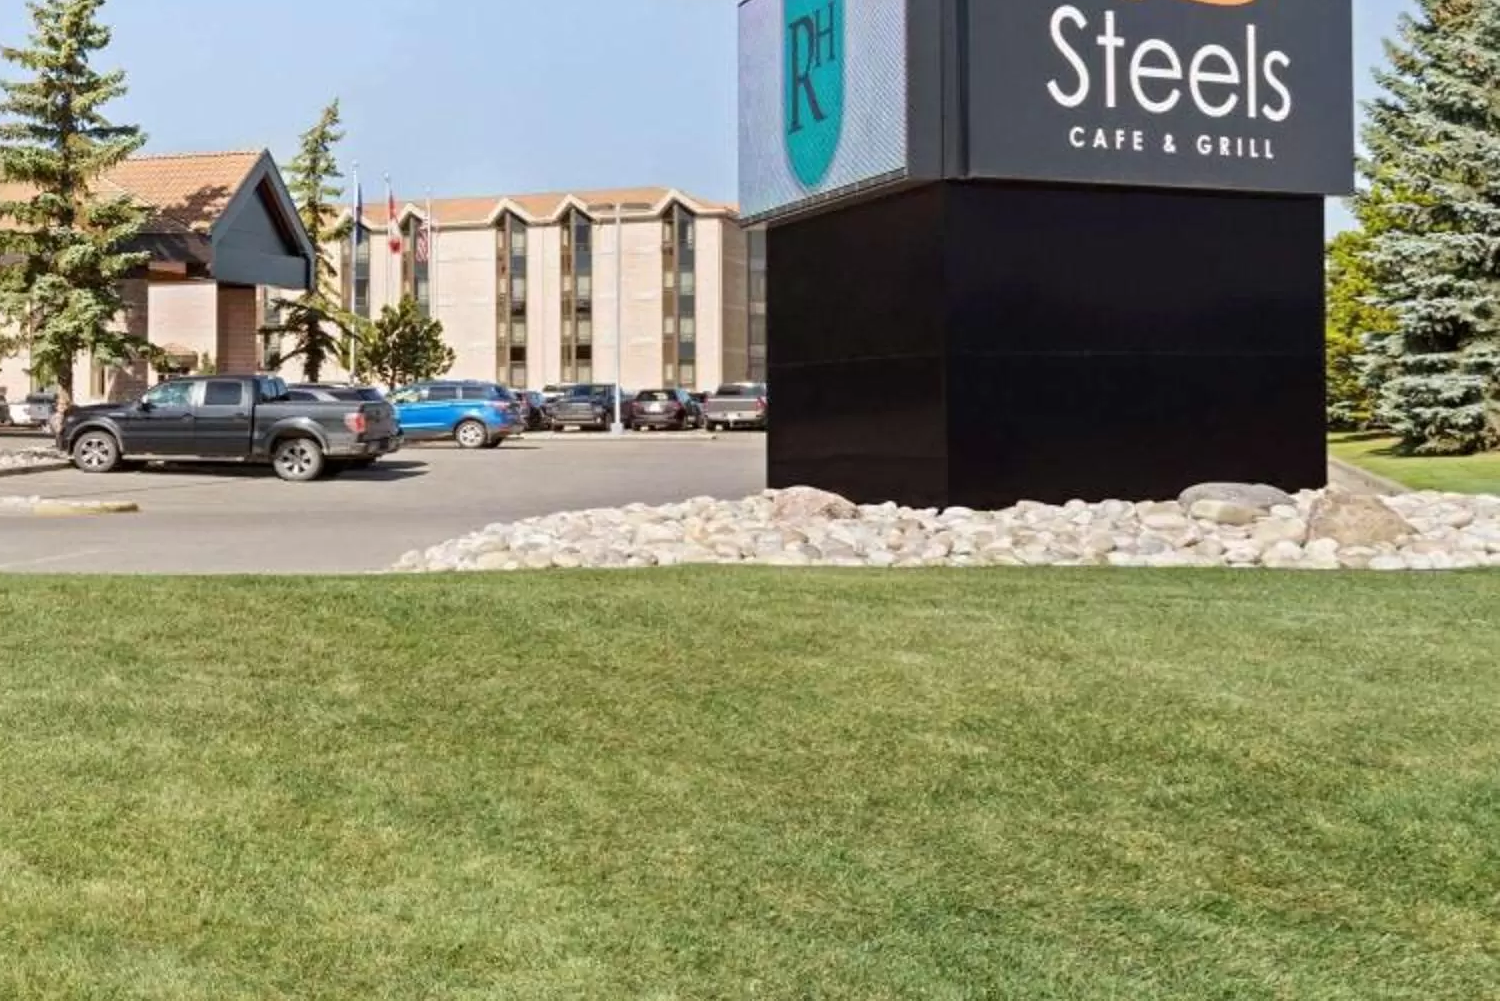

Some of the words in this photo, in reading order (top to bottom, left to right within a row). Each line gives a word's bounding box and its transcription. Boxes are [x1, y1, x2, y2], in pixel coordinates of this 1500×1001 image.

[1046, 4, 1292, 122] Steels
[1068, 126, 1144, 151] CAFE
[1162, 133, 1176, 153] &
[1196, 135, 1275, 159] GRILL
